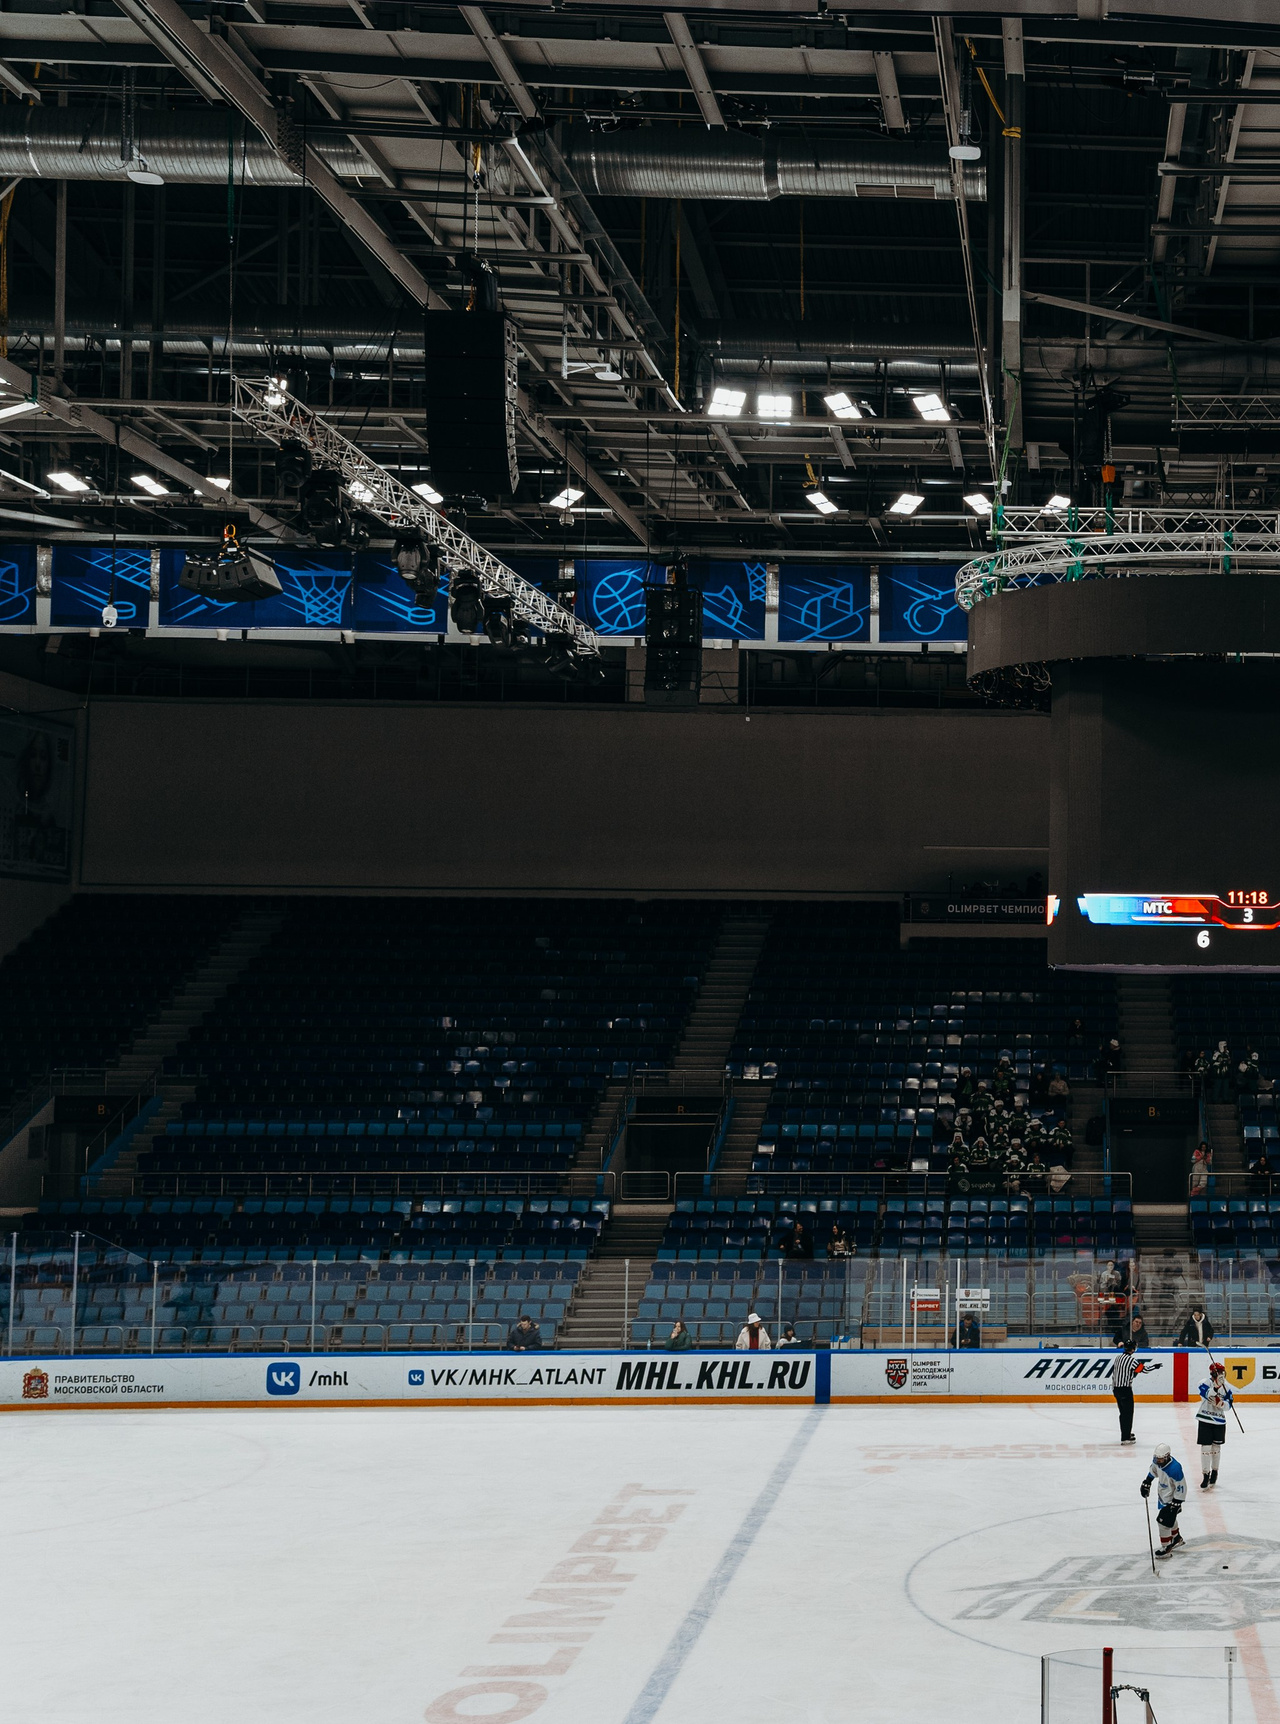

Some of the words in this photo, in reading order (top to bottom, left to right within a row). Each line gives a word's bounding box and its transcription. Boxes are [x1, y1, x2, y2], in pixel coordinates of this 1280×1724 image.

[1228, 891, 1268, 905] 11:18
[947, 904, 999, 914] OLIMPBET
[1001, 905, 1045, 914] ЧЕМПИО
[1243, 908, 1253, 923] 3
[1196, 930, 1210, 948] 6
[54, 1374, 135, 1384] ПРАВИТЕЛЬСТВО
[308, 1370, 349, 1387] /mhl
[431, 1369, 607, 1386] VK/MHK_ATLANT
[616, 1361, 811, 1391] MHL.KHL.RU
[54, 1384, 119, 1394] МОСКОВСКОЙ
[121, 1384, 164, 1394] ОБЛАСТИ
